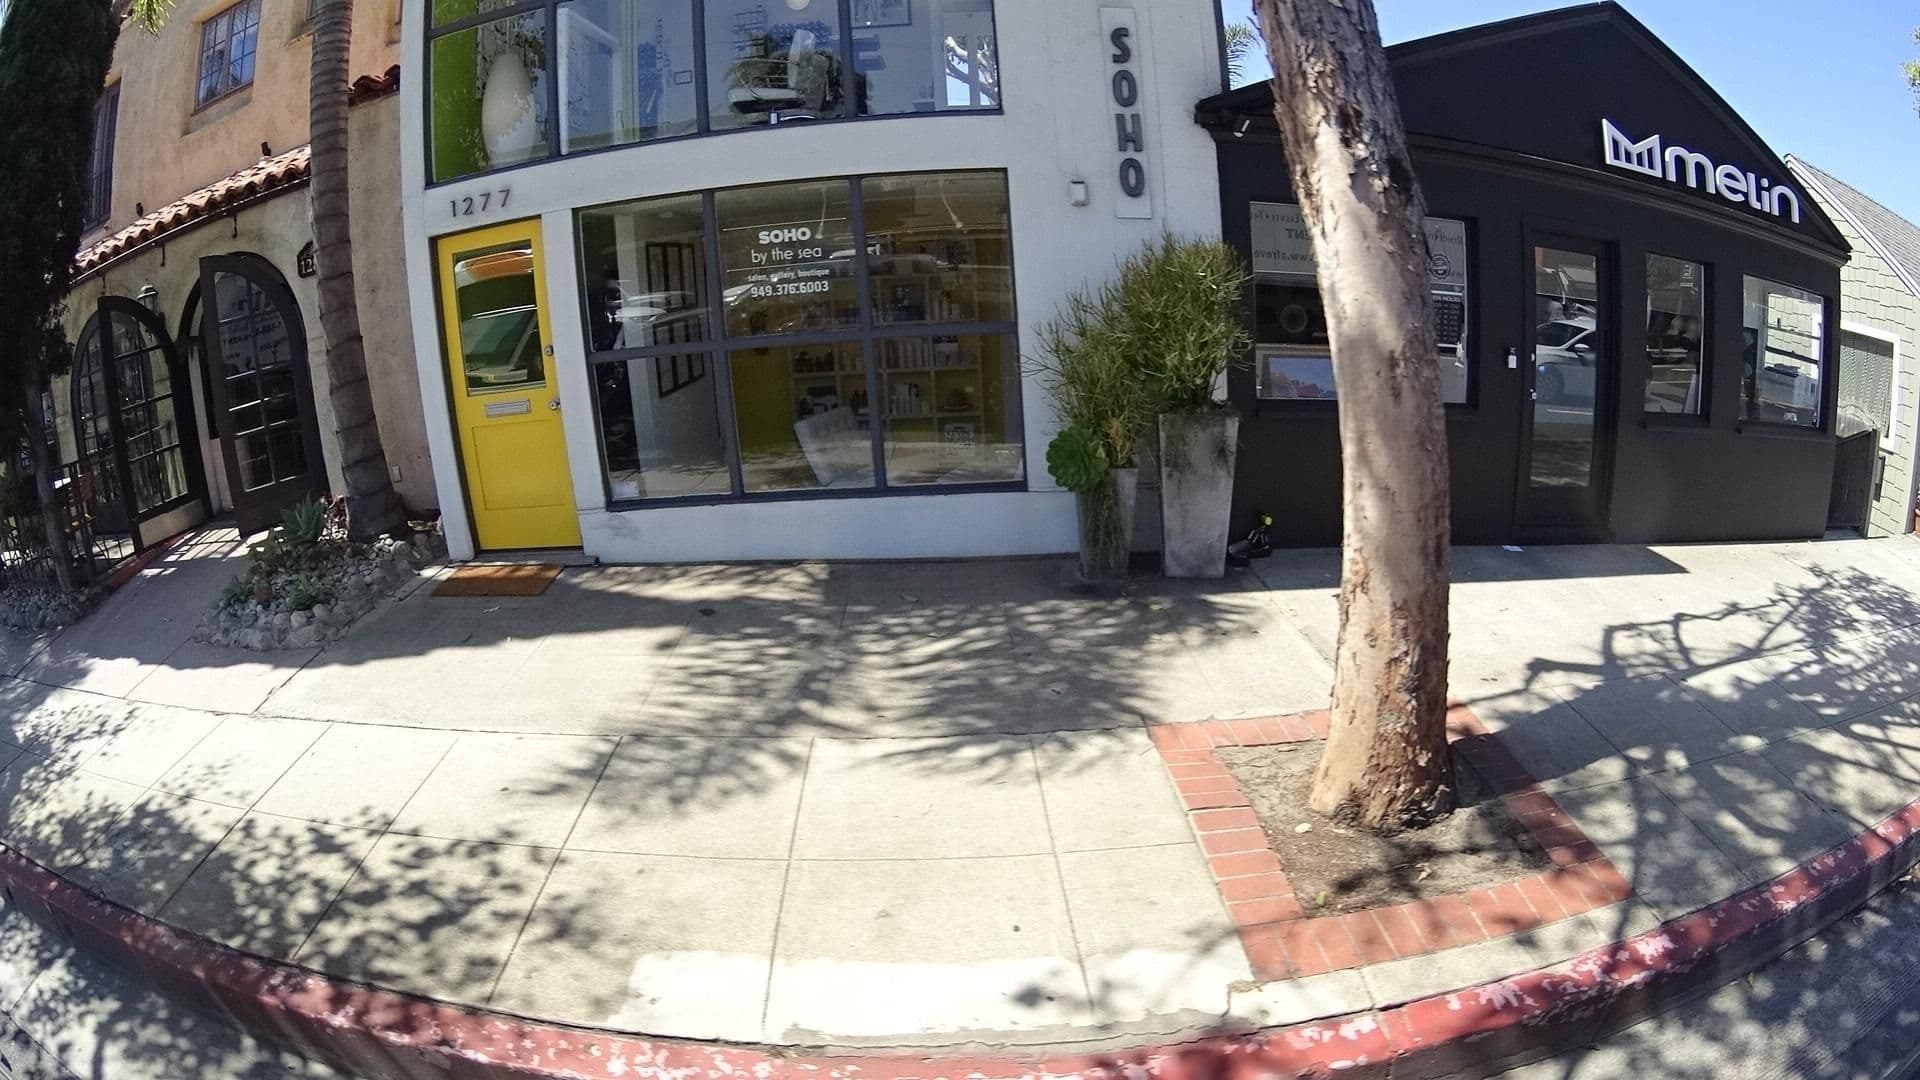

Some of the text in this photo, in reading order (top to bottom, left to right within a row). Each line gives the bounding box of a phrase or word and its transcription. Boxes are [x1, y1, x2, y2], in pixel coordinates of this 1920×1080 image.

[1110, 26, 1146, 198] SOHO
[1664, 146, 1800, 224] melin
[449, 188, 511, 217] 1277
[758, 227, 812, 245] SOHO
[751, 247, 822, 265] by the sea
[750, 280, 830, 298] 949.376.6003
